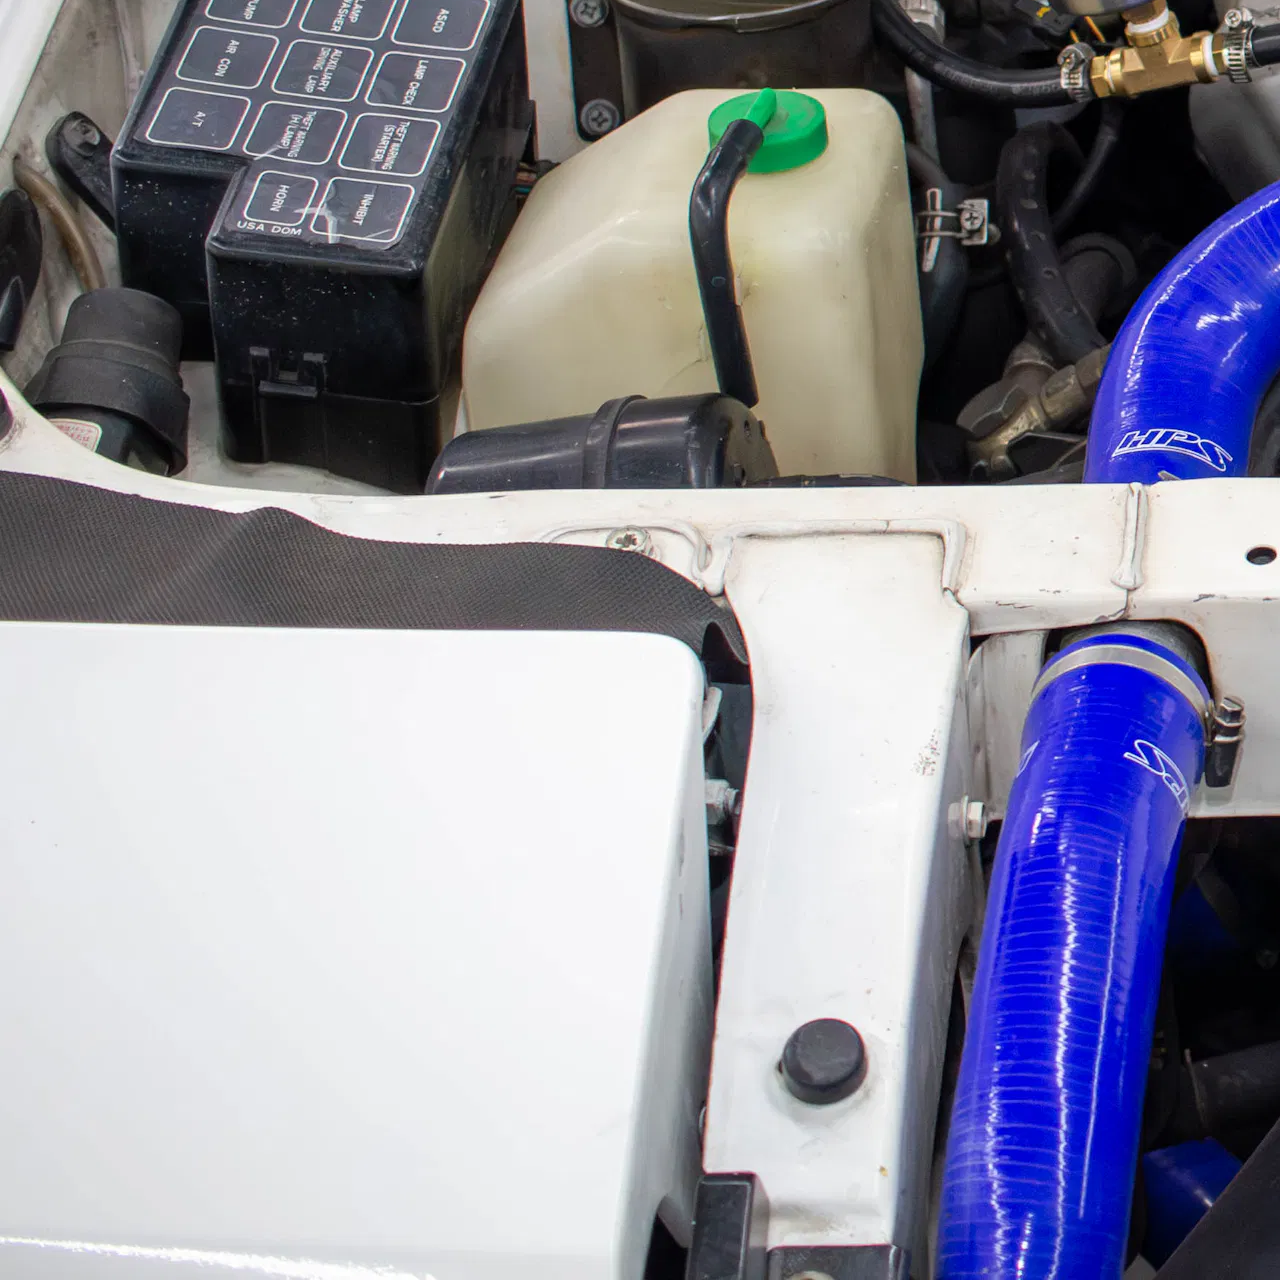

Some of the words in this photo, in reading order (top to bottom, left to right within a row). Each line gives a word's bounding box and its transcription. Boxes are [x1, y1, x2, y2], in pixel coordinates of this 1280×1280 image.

[432, 8, 450, 34] ASCD
[225, 39, 240, 55] AIR
[214, 58, 231, 77] CON
[316, 48, 343, 93] AUXILIARY
[414, 59, 429, 80] LAMP
[304, 75, 319, 94] LAMP
[402, 81, 421, 106] CHECK
[192, 110, 206, 128] A/T
[302, 111, 317, 131] THEFT
[395, 121, 411, 142] THEFT
[287, 131, 307, 158] WARNING
[371, 124, 397, 163] (STARTER)
[381, 142, 401, 170] WARNING
[269, 184, 290, 212] HORN
[353, 193, 375, 226] INHIBIT
[236, 220, 265, 232] USA
[271, 225, 302, 236] DOM
[1111, 428, 1233, 472] HPS
[1123, 739, 1190, 814] PS
